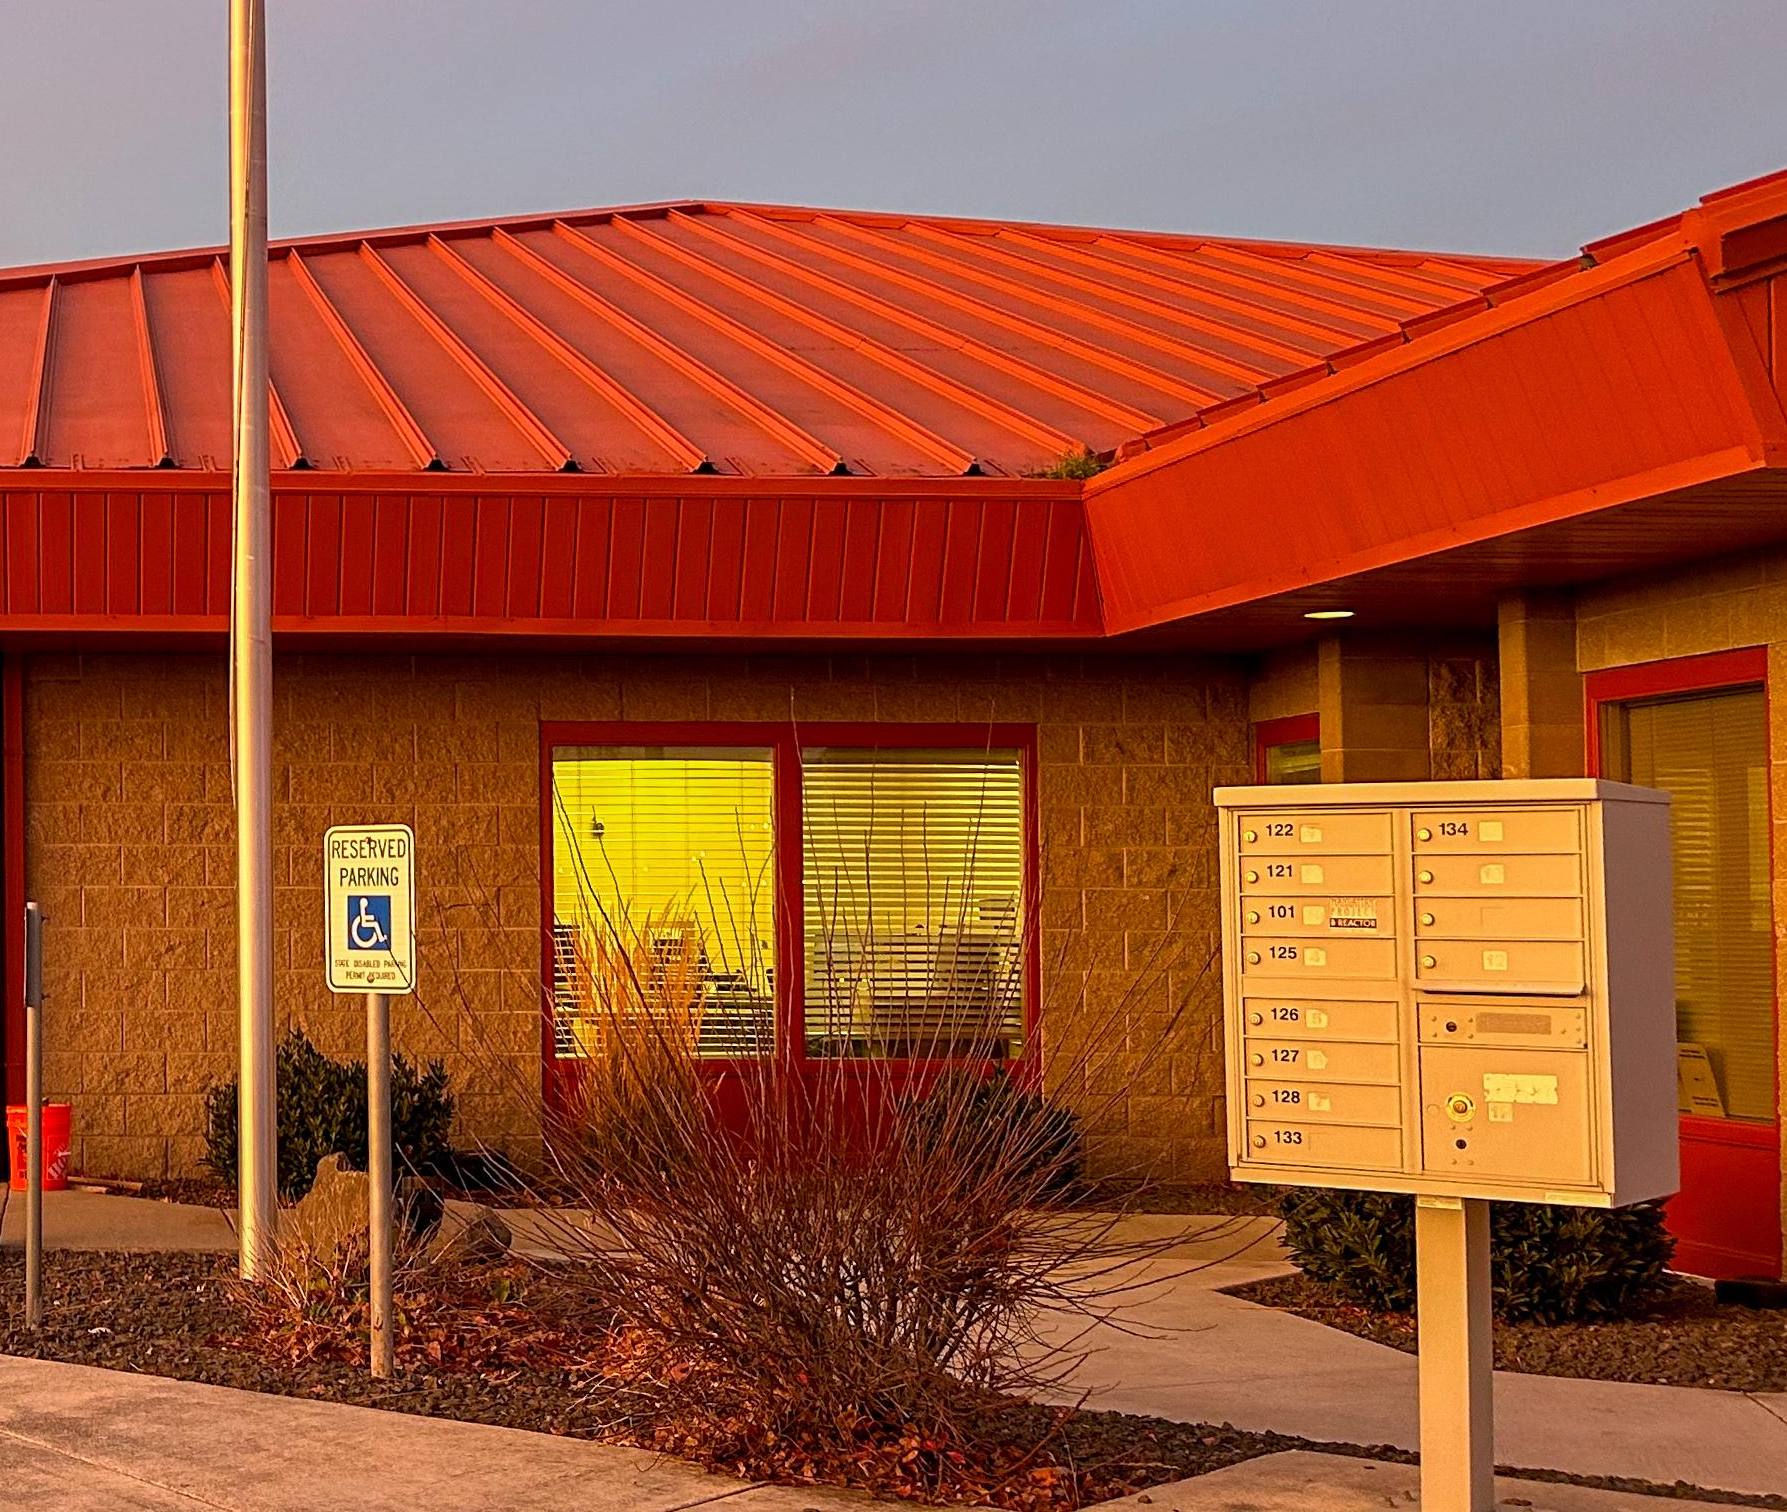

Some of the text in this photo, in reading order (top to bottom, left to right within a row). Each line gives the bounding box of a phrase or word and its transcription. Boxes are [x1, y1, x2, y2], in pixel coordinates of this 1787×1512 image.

[1266, 823, 1294, 837] 122
[1438, 822, 1469, 836] 134
[332, 838, 406, 859] RESERVED
[340, 867, 399, 887] PARKING
[1266, 864, 1293, 877] 121
[1268, 905, 1295, 918] 101
[1337, 919, 1376, 927] REACTOR
[1270, 946, 1297, 959] 125
[1271, 1008, 1299, 1021] 126
[1272, 1049, 1299, 1062] 127
[1272, 1090, 1301, 1103] 128
[1274, 1130, 1303, 1144] 133
